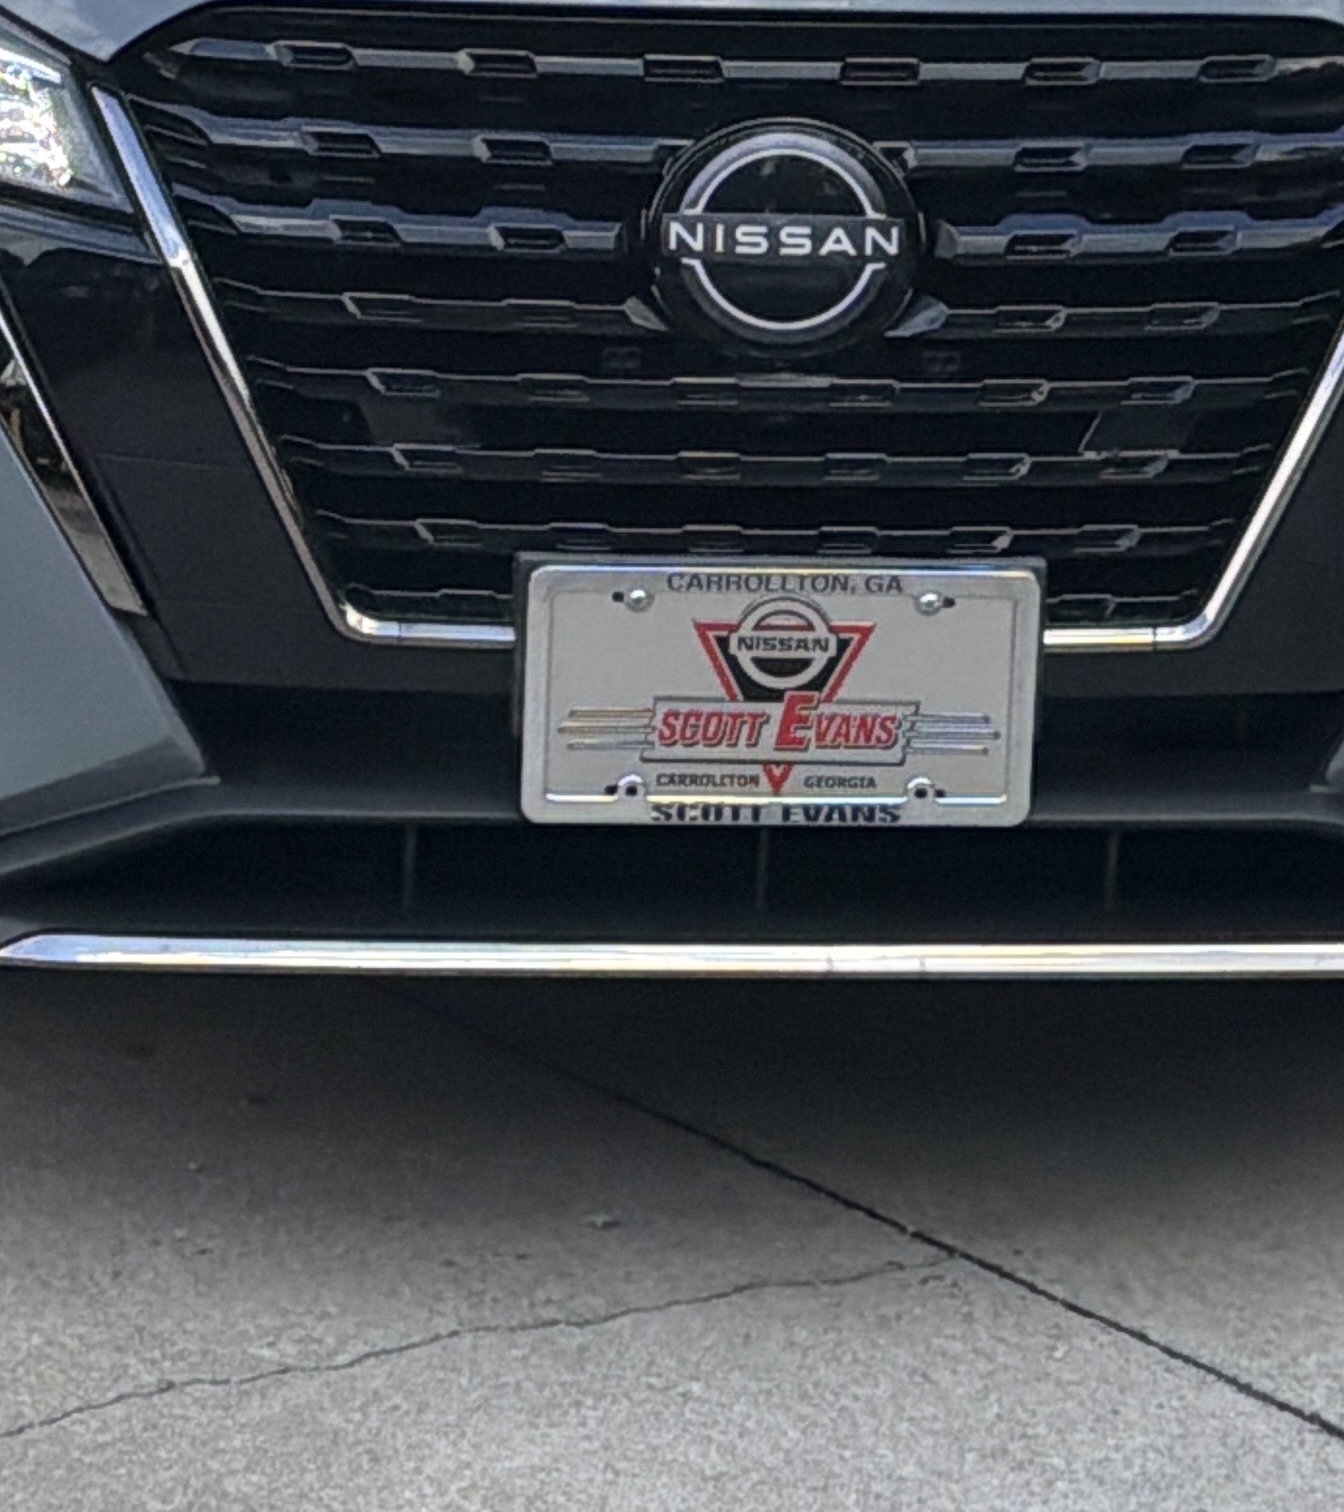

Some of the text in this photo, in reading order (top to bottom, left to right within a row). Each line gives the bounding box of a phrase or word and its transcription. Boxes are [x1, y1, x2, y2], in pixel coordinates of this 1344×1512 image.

[667, 220, 900, 257] NISSAN
[666, 571, 904, 595] CARROLLTON, GA
[737, 634, 830, 652] NISSAN
[657, 690, 902, 752] SCOTT EVANS
[656, 772, 878, 790] CARROLLTON GEORGIA
[650, 802, 902, 824] SCOTT EVANS
